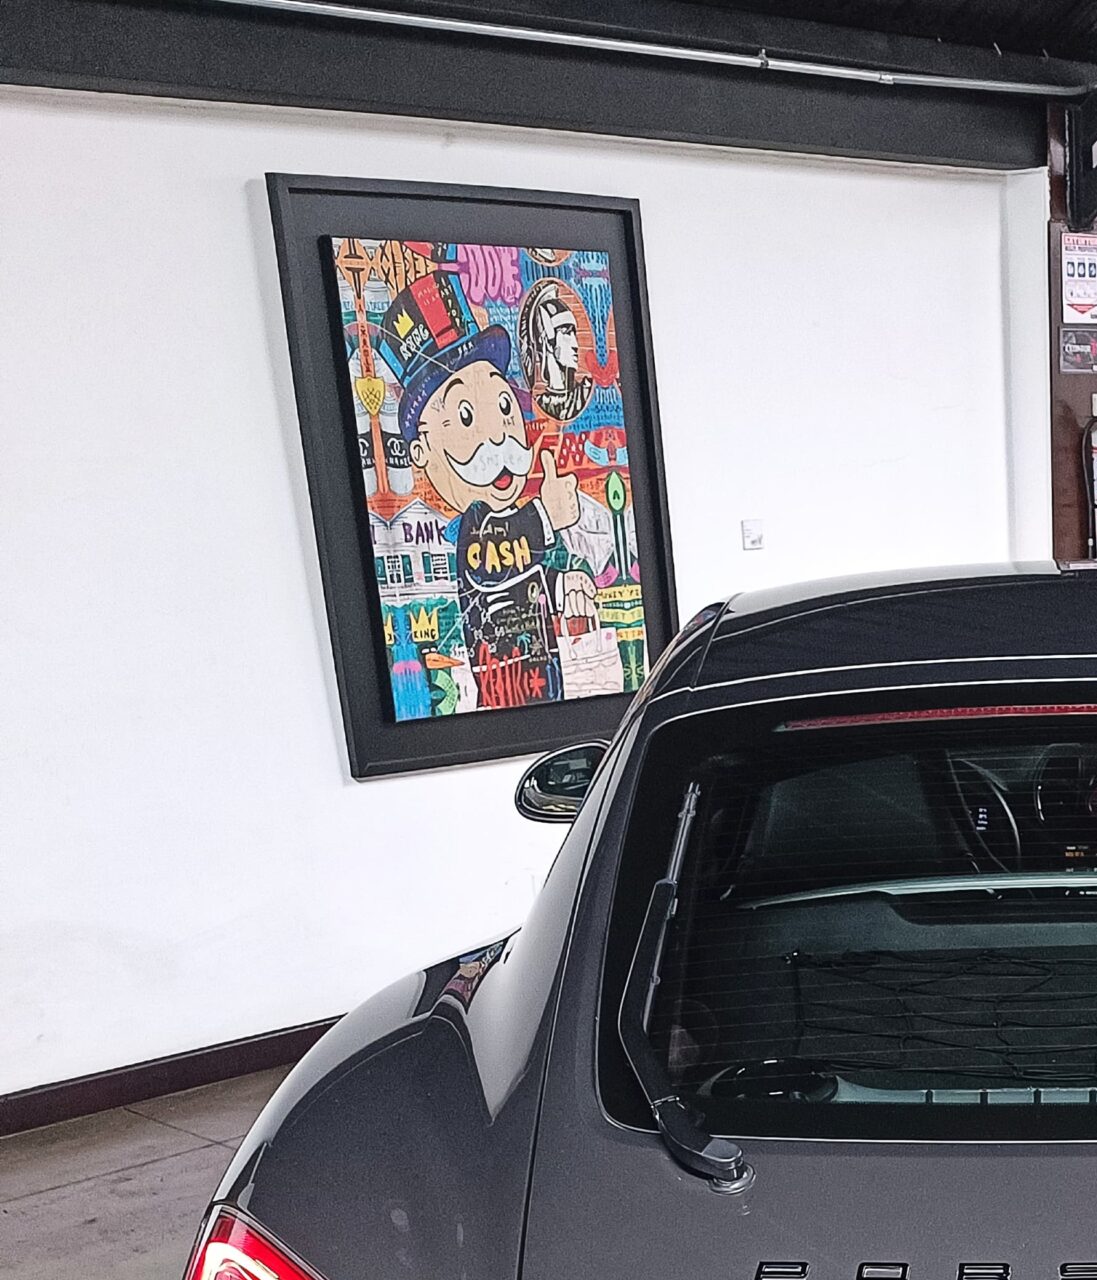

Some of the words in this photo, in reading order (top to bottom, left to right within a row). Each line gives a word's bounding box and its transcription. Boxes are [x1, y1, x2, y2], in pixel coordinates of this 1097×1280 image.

[400, 324, 430, 361] KING
[402, 519, 447, 547] BANK
[467, 536, 532, 574] CASH
[413, 628, 437, 640] KING
